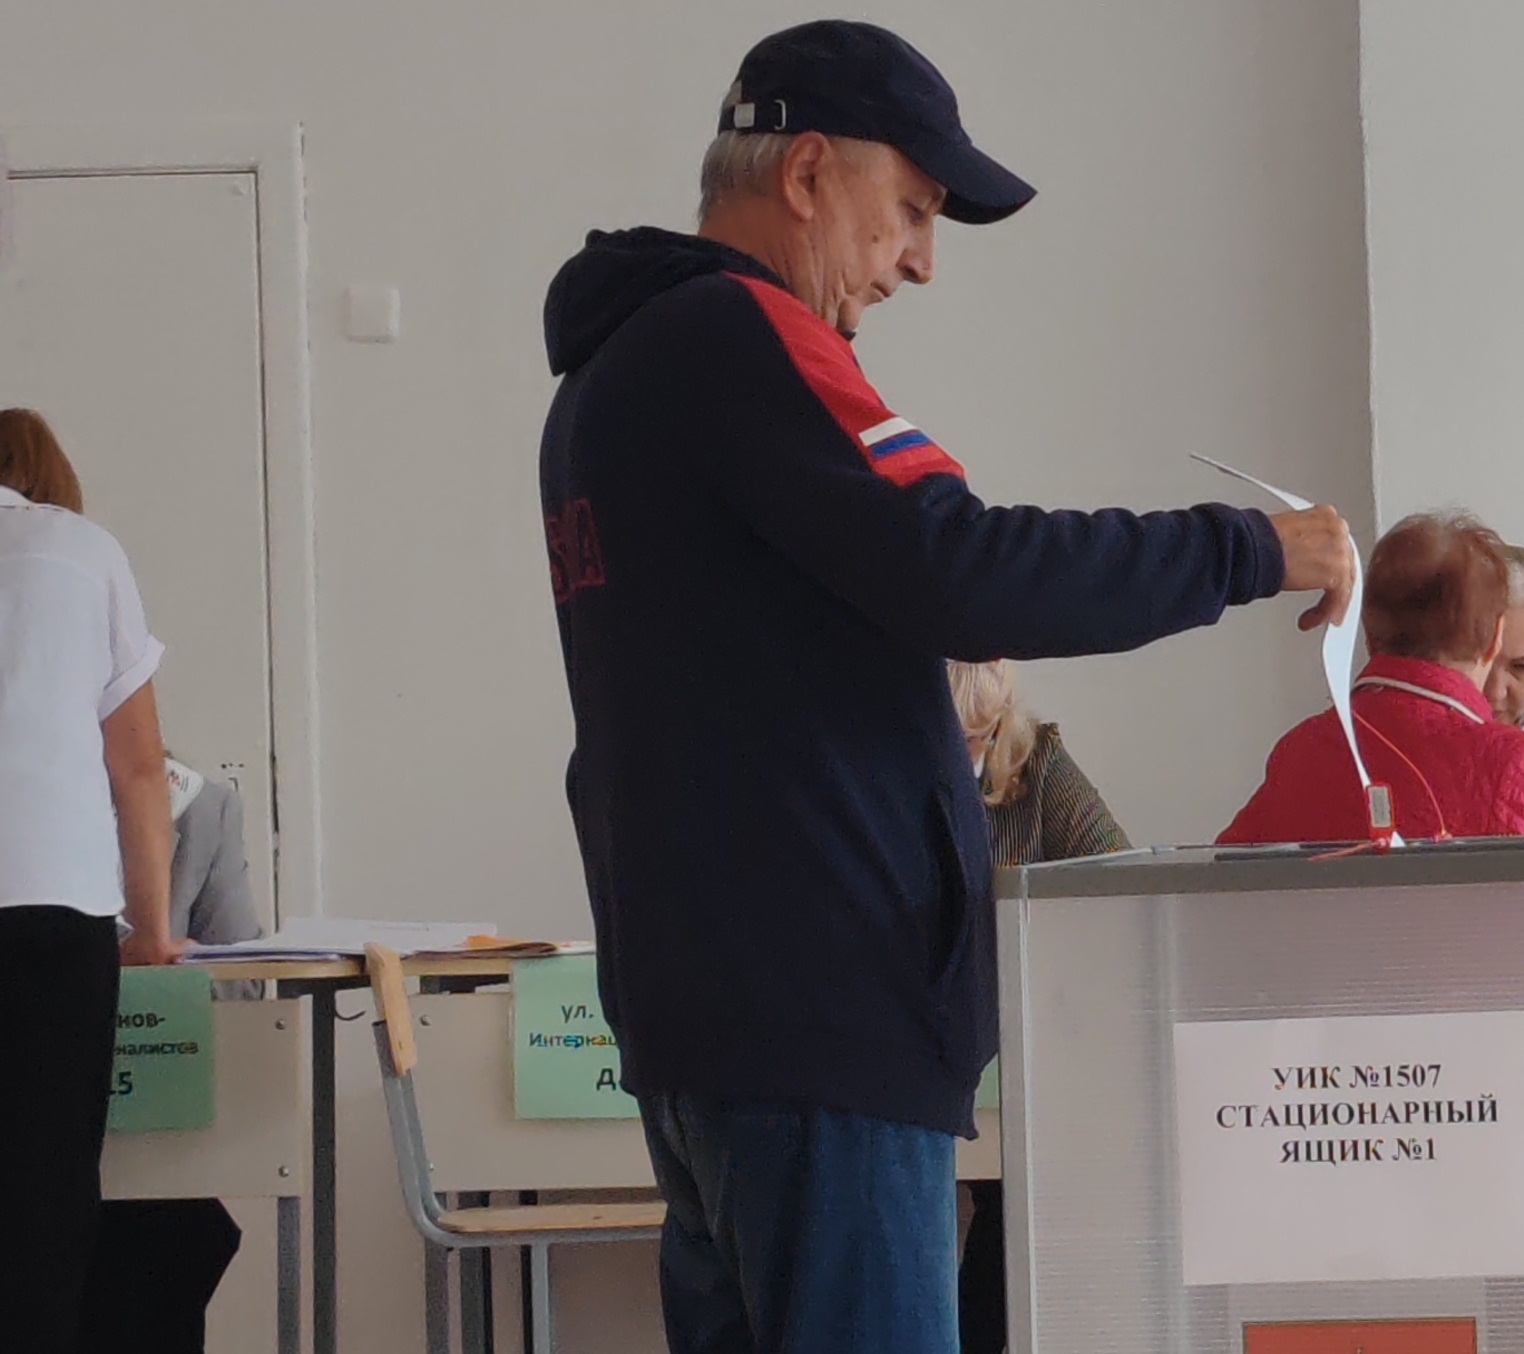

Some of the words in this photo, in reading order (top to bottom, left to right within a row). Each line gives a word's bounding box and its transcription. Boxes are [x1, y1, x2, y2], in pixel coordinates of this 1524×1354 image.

[117, 1012, 166, 1029] нов-
[561, 1004, 595, 1024] ул.
[1271, 1066, 1341, 1091] УИК
[1349, 1064, 1443, 1089] №1507
[1215, 1093, 1499, 1130] СТАЦИОНАРНЫЙ
[1280, 1139, 1385, 1168] ЯЩИК
[1391, 1137, 1437, 1162] №1
